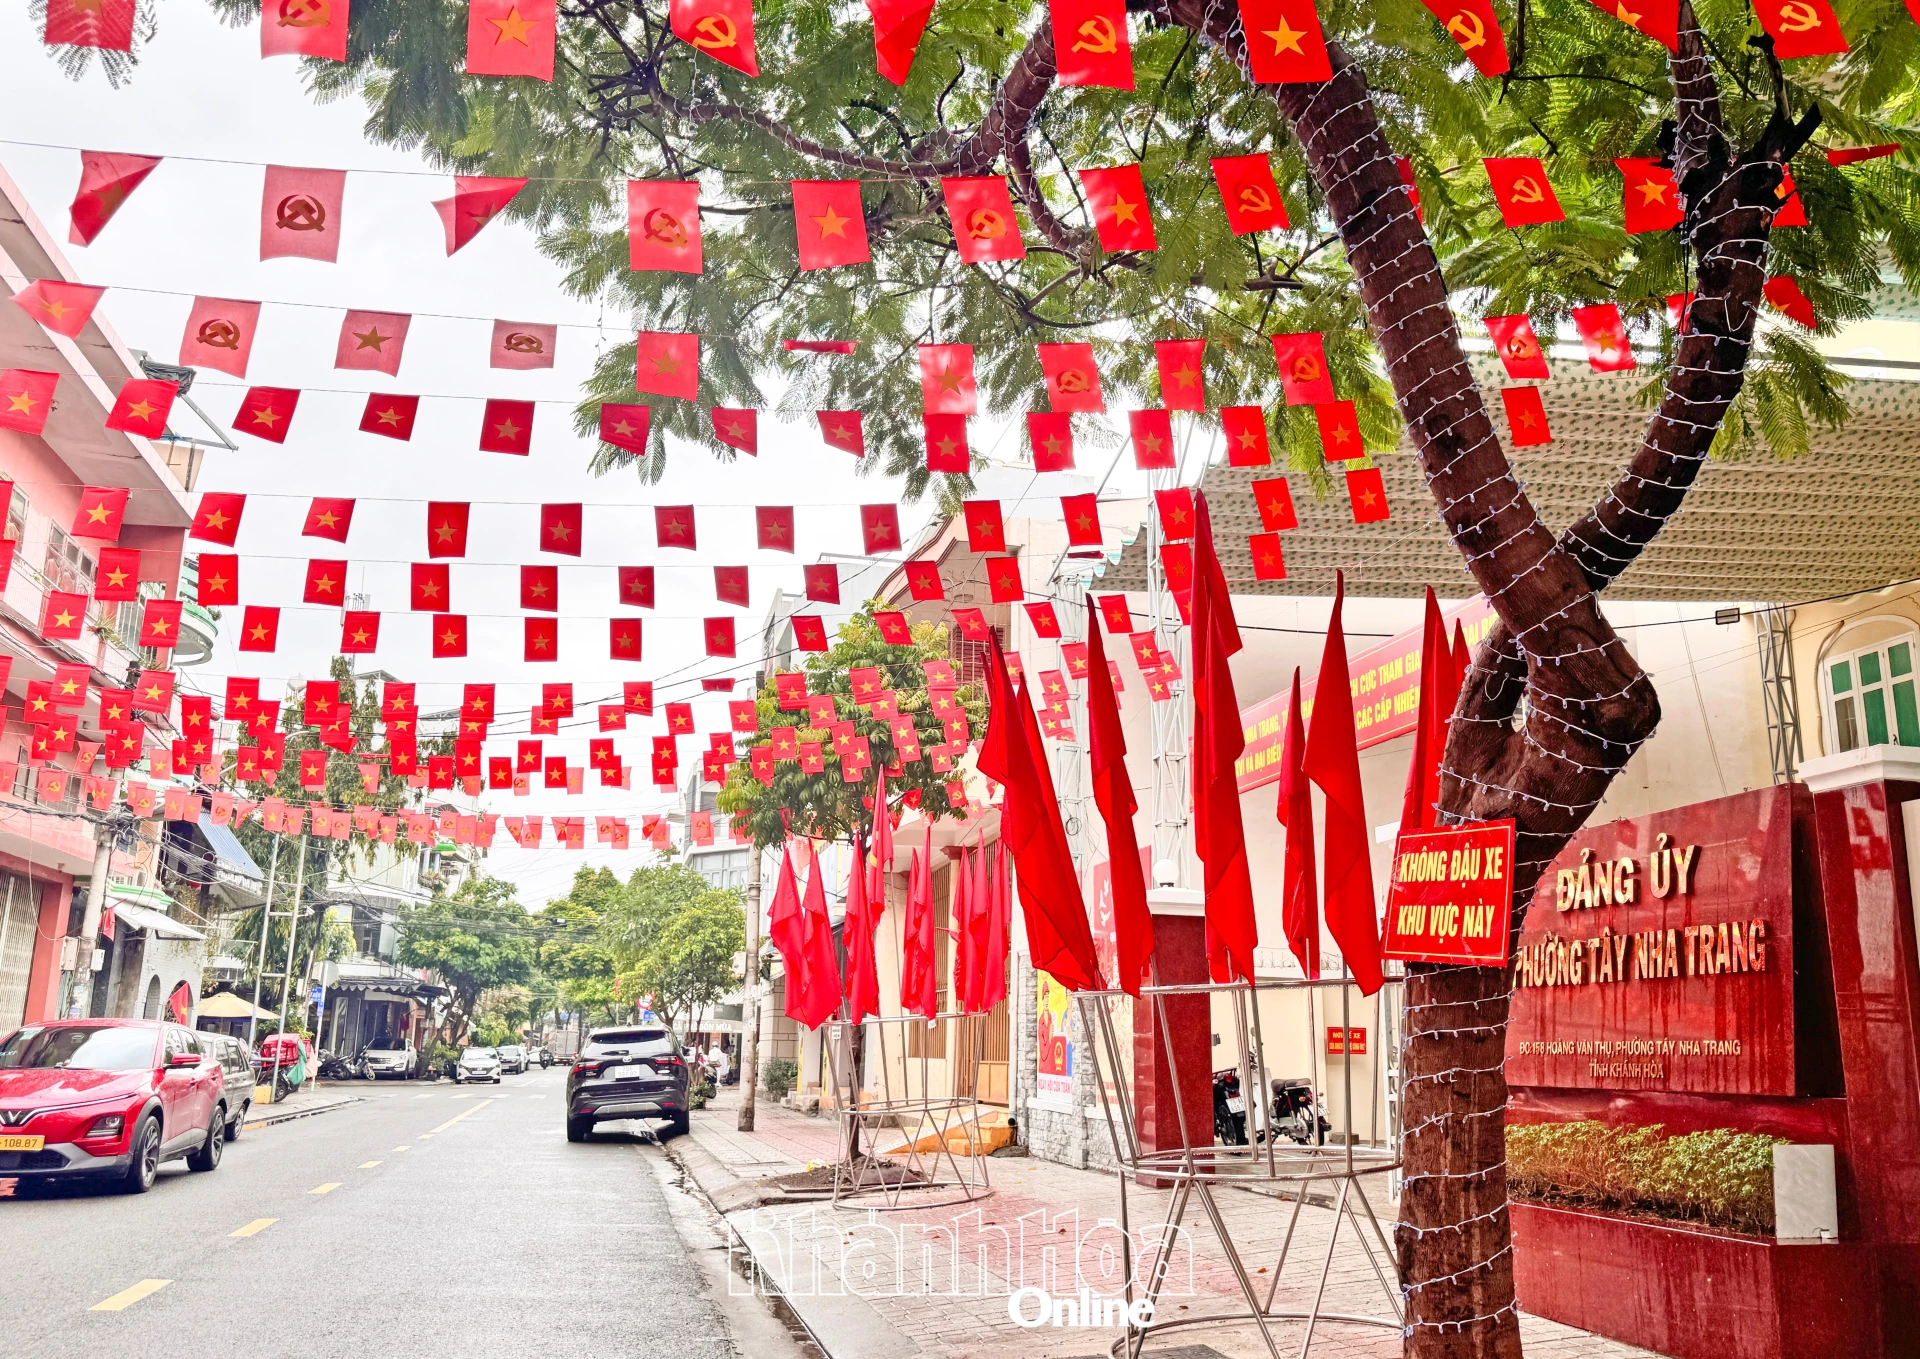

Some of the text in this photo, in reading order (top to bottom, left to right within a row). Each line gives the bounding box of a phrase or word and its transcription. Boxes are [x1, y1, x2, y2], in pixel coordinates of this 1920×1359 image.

[1360, 668, 1377, 696] CỰC
[1378, 656, 1403, 687] THAM
[1406, 649, 1421, 675] GIA
[1356, 703, 1373, 731] CÁC
[1375, 692, 1392, 724] CẤP
[1399, 842, 1504, 888] KHÔNG ĐẬU XE
[1556, 832, 1701, 912] ĐẢNG ỦY
[1397, 898, 1495, 943] KHU VỰC NÀY
[1512, 918, 1767, 989] PHƯỜNG TÂY NHA TRANG
[1546, 1037, 1575, 1056] HOÀNG
[1594, 1040, 1615, 1060] THỤ,
[1616, 1036, 1654, 1056] PHƯỜNG
[1656, 1036, 1676, 1056] TÂY
[1679, 1040, 1701, 1056] NHA
[1703, 1039, 1742, 1056] TRANG
[1609, 1060, 1643, 1078] KHÁNH
[1643, 1060, 1664, 1079] HÒA
